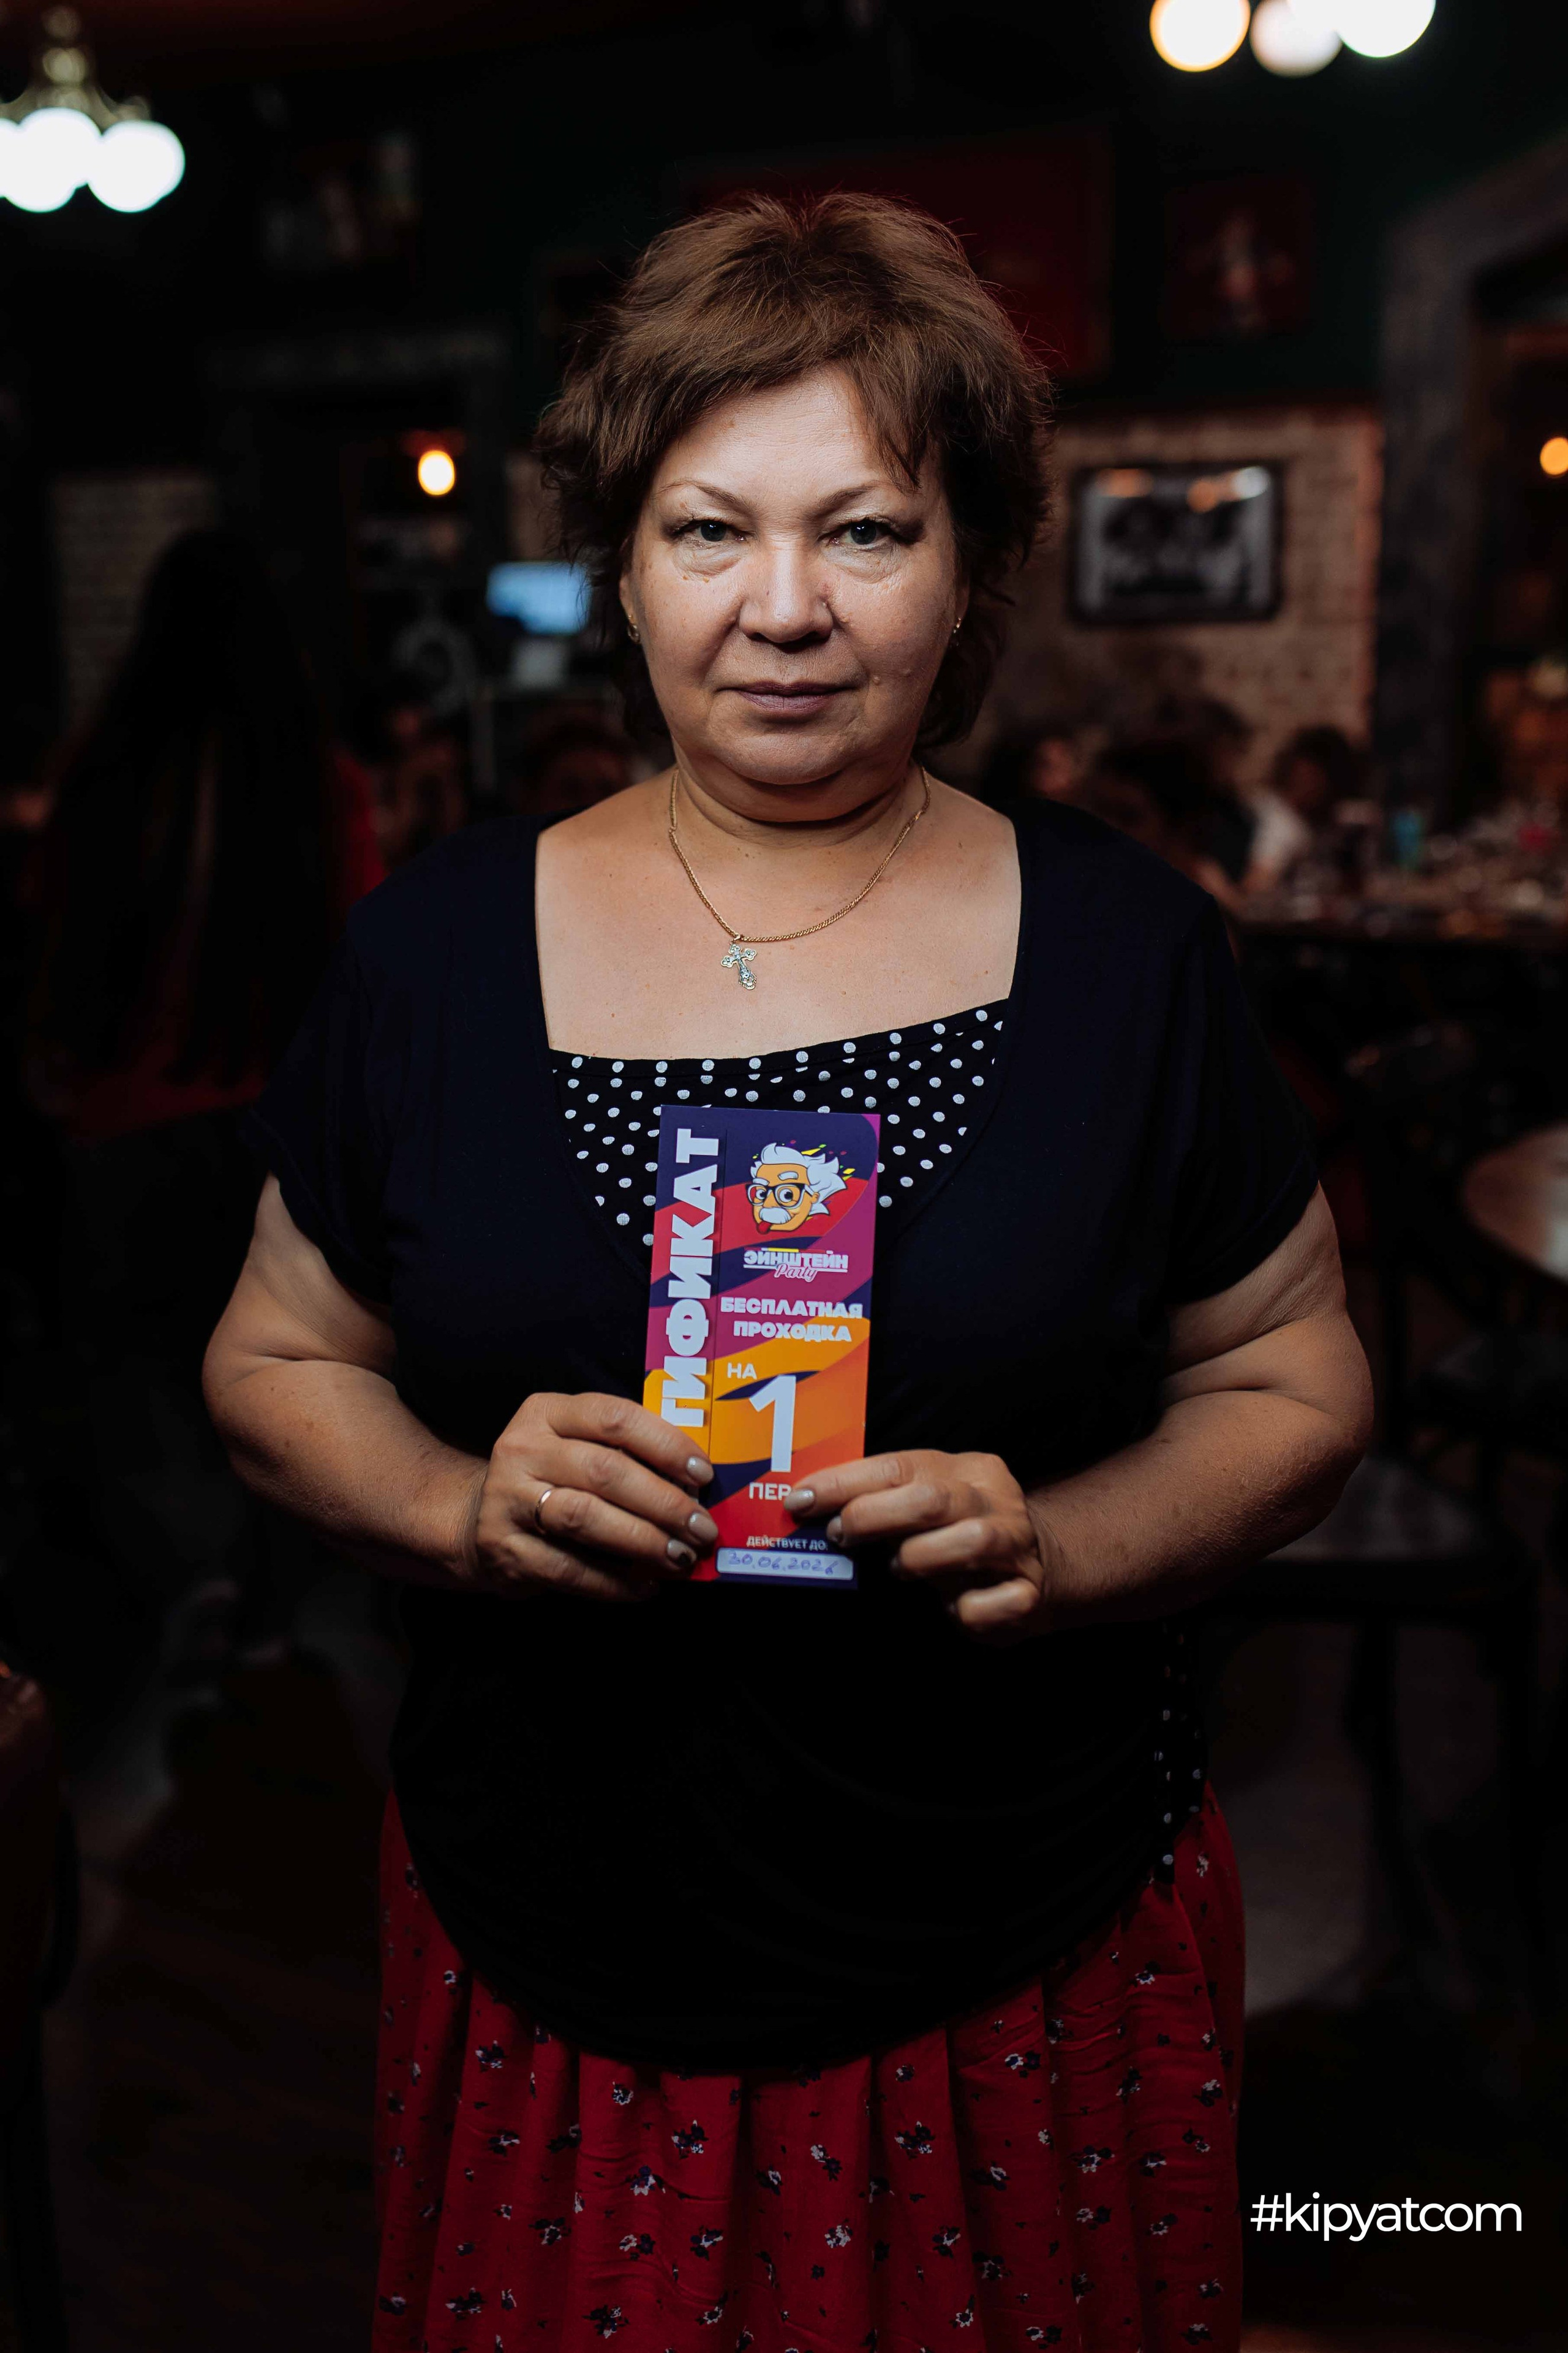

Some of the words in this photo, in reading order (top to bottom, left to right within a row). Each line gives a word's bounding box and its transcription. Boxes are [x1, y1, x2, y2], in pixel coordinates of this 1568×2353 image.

[661, 1128, 719, 1427] ТИФИКАТ
[774, 1263, 818, 1283] Party
[720, 1297, 864, 1320] БЕСПЛАТНАЯ
[733, 1321, 853, 1342] ПРОХОДКА
[727, 1362, 758, 1380] НА
[748, 1374, 797, 1473] 1
[748, 1482, 792, 1501] ПЕР
[746, 1535, 808, 1549] ДЕЙСТВУЕТ
